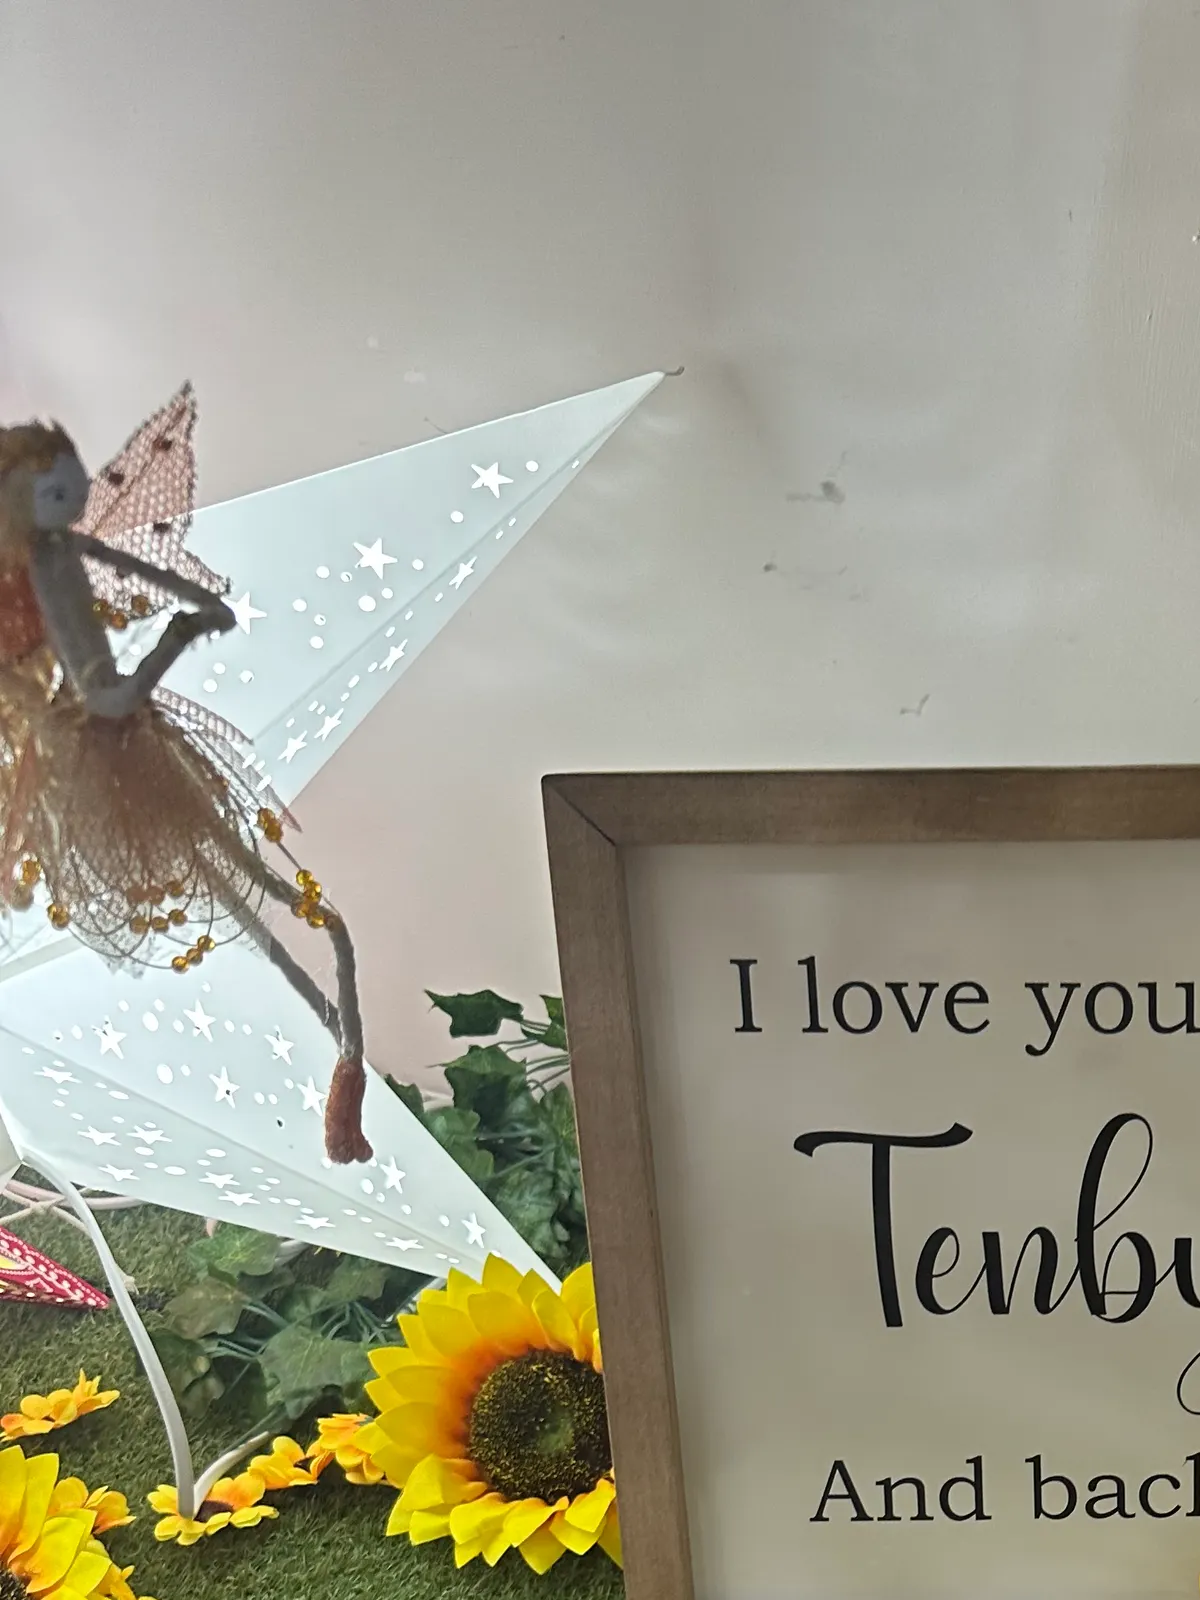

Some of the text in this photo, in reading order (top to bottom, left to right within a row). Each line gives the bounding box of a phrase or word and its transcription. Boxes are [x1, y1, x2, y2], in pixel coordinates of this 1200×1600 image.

[729, 958, 763, 1033] I
[796, 955, 990, 1035] love
[809, 1455, 992, 1523] And
